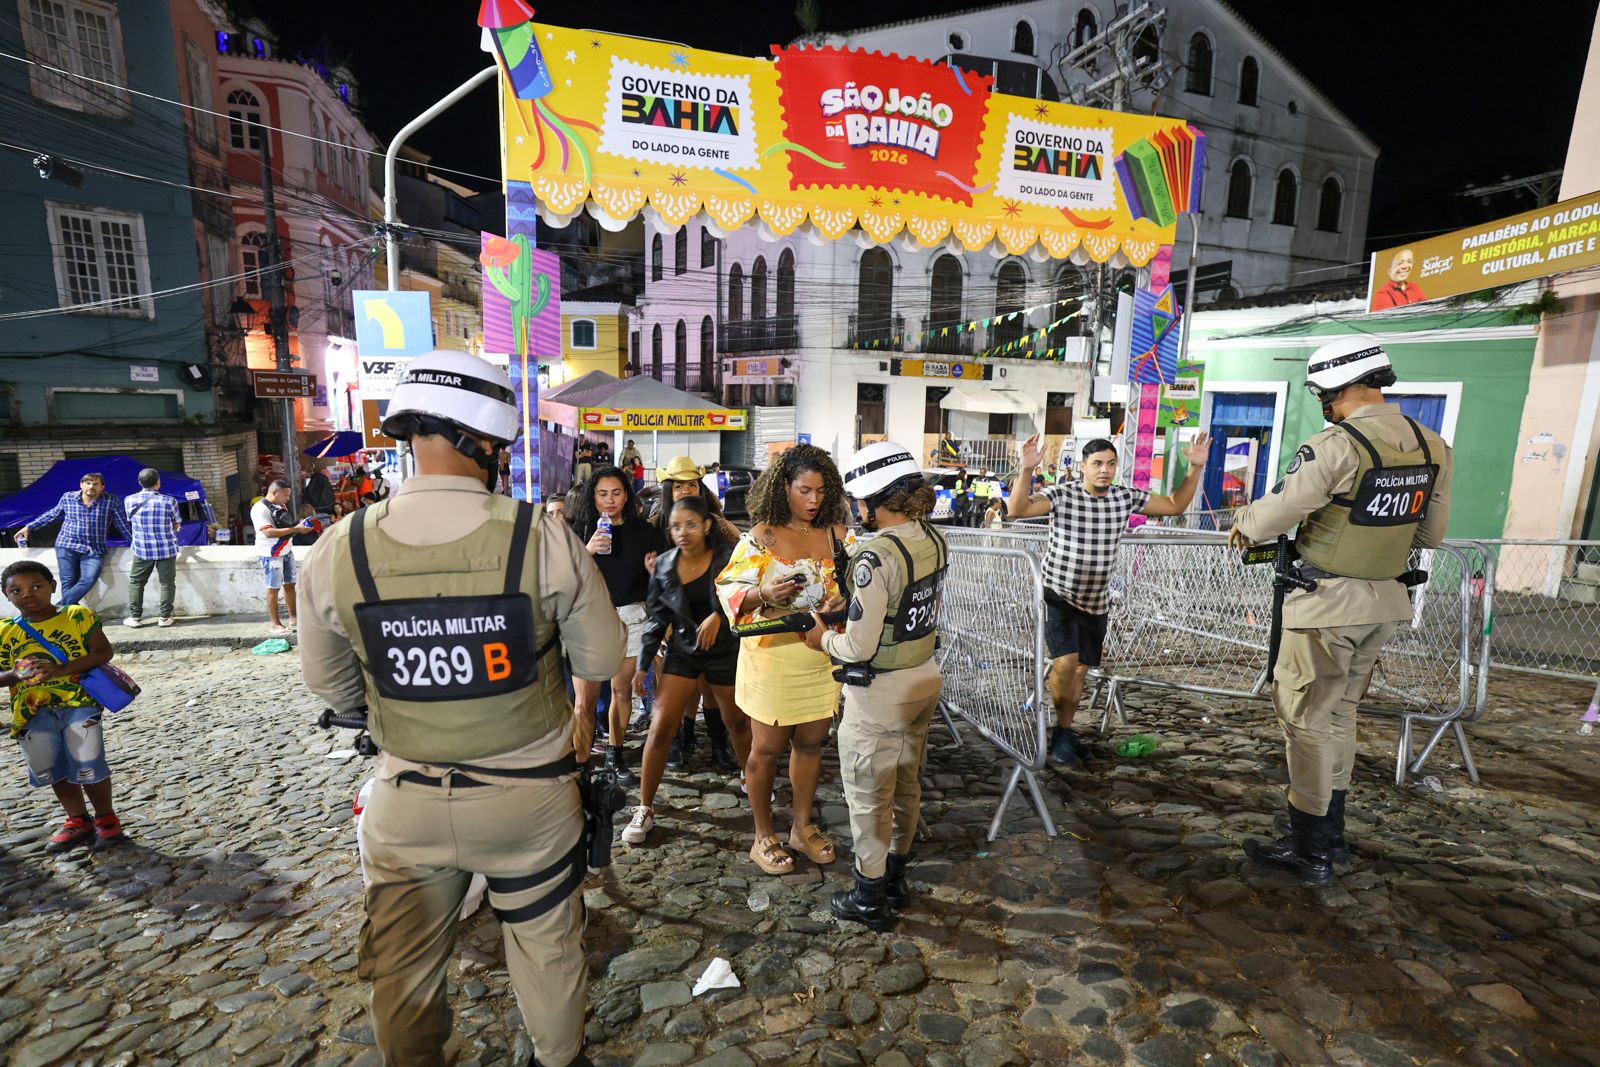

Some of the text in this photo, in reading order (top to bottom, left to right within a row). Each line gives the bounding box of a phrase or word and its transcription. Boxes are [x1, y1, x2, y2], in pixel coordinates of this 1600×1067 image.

[622, 75, 740, 106] GOVERNO DA
[820, 81, 953, 128] SÃO JOÃO
[621, 92, 740, 136] BAHIA
[632, 140, 730, 160] DO LADO DA GENTE
[825, 113, 941, 160] DA BAHIA
[1015, 129, 1104, 155] GOVERNO DA
[869, 149, 909, 166] 2026
[1013, 144, 1105, 181] BAHIA
[1020, 185, 1094, 202] DO LADO DA GENTE
[1461, 219, 1600, 265] DE HISTÓRIA, MARCA
[1462, 221, 1528, 250] PARABÉNS
[1529, 214, 1551, 233] AO
[1481, 236, 1597, 276] CULTURA, ARTE E
[417, 372, 462, 386] MILITAR
[1374, 473, 1429, 488] POLÍCIA MILITAR
[1366, 490, 1425, 517] 4210 D
[381, 614, 507, 638] POLÍCIA MILITAR
[49, 629, 81, 658] MORRO
[387, 641, 513, 687] 3269 B
